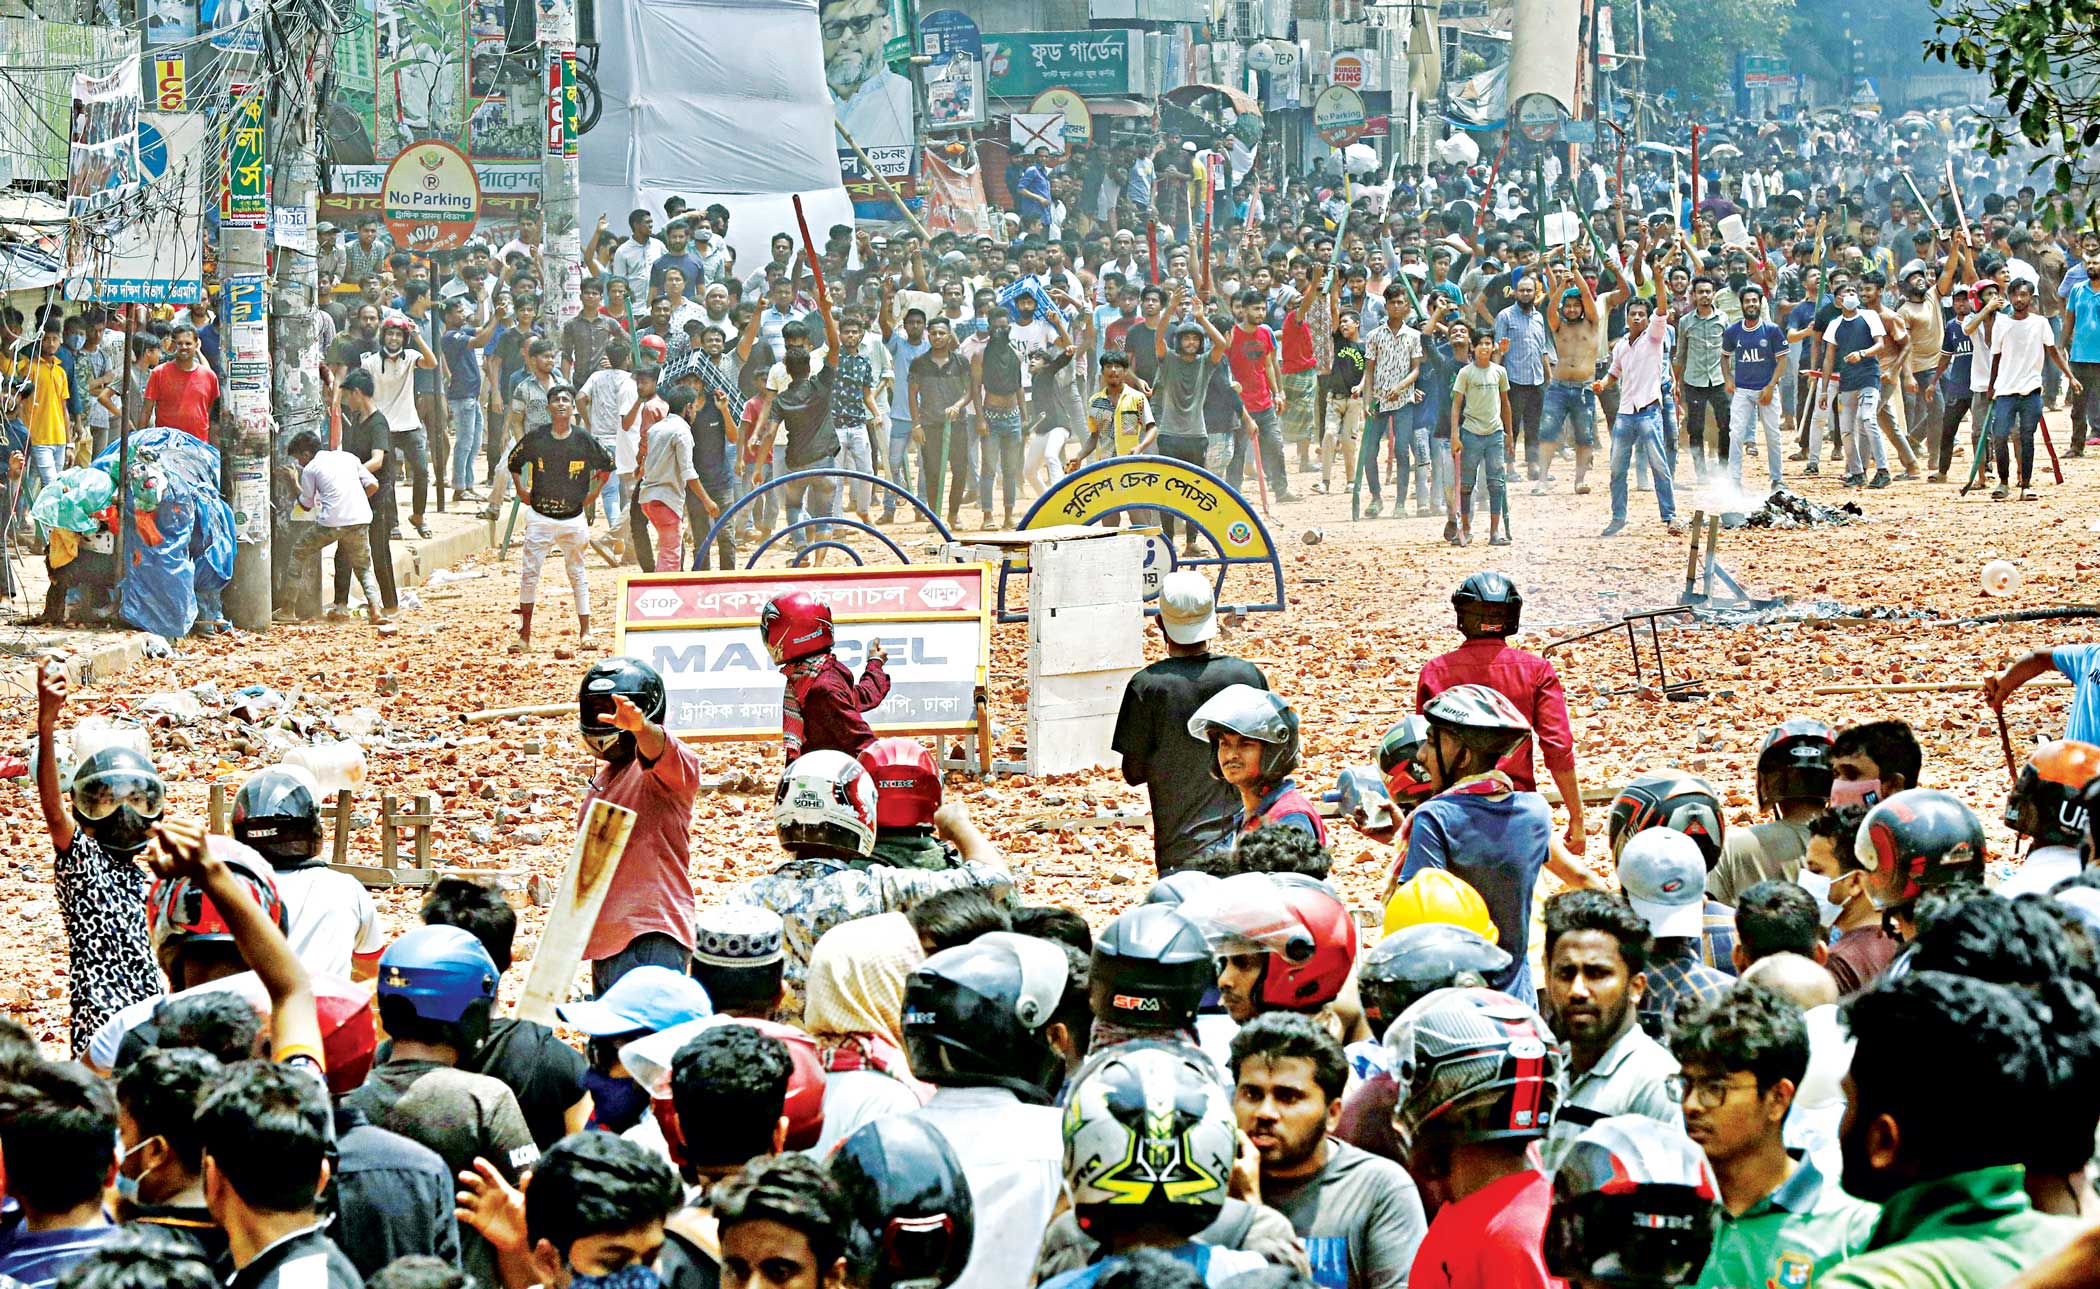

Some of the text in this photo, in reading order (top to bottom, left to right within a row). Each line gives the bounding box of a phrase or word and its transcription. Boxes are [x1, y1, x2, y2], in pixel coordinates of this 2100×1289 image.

[1029, 35, 1125, 69] ফুড গার্ডেন
[1274, 53, 1294, 65] TEP
[1334, 65, 1361, 73] BURGER
[1334, 73, 1362, 82] KING
[1330, 111, 1361, 120] Parking
[389, 191, 472, 210] No Parking
[1063, 472, 1221, 518] পুলিশ চেক পোস্ট
[640, 598, 678, 609] STOP
[653, 637, 948, 674] MACEL
[680, 700, 735, 723] ট্রাফিক
[922, 695, 961, 713] ঢাকা
[1113, 994, 1160, 1011] SFM
